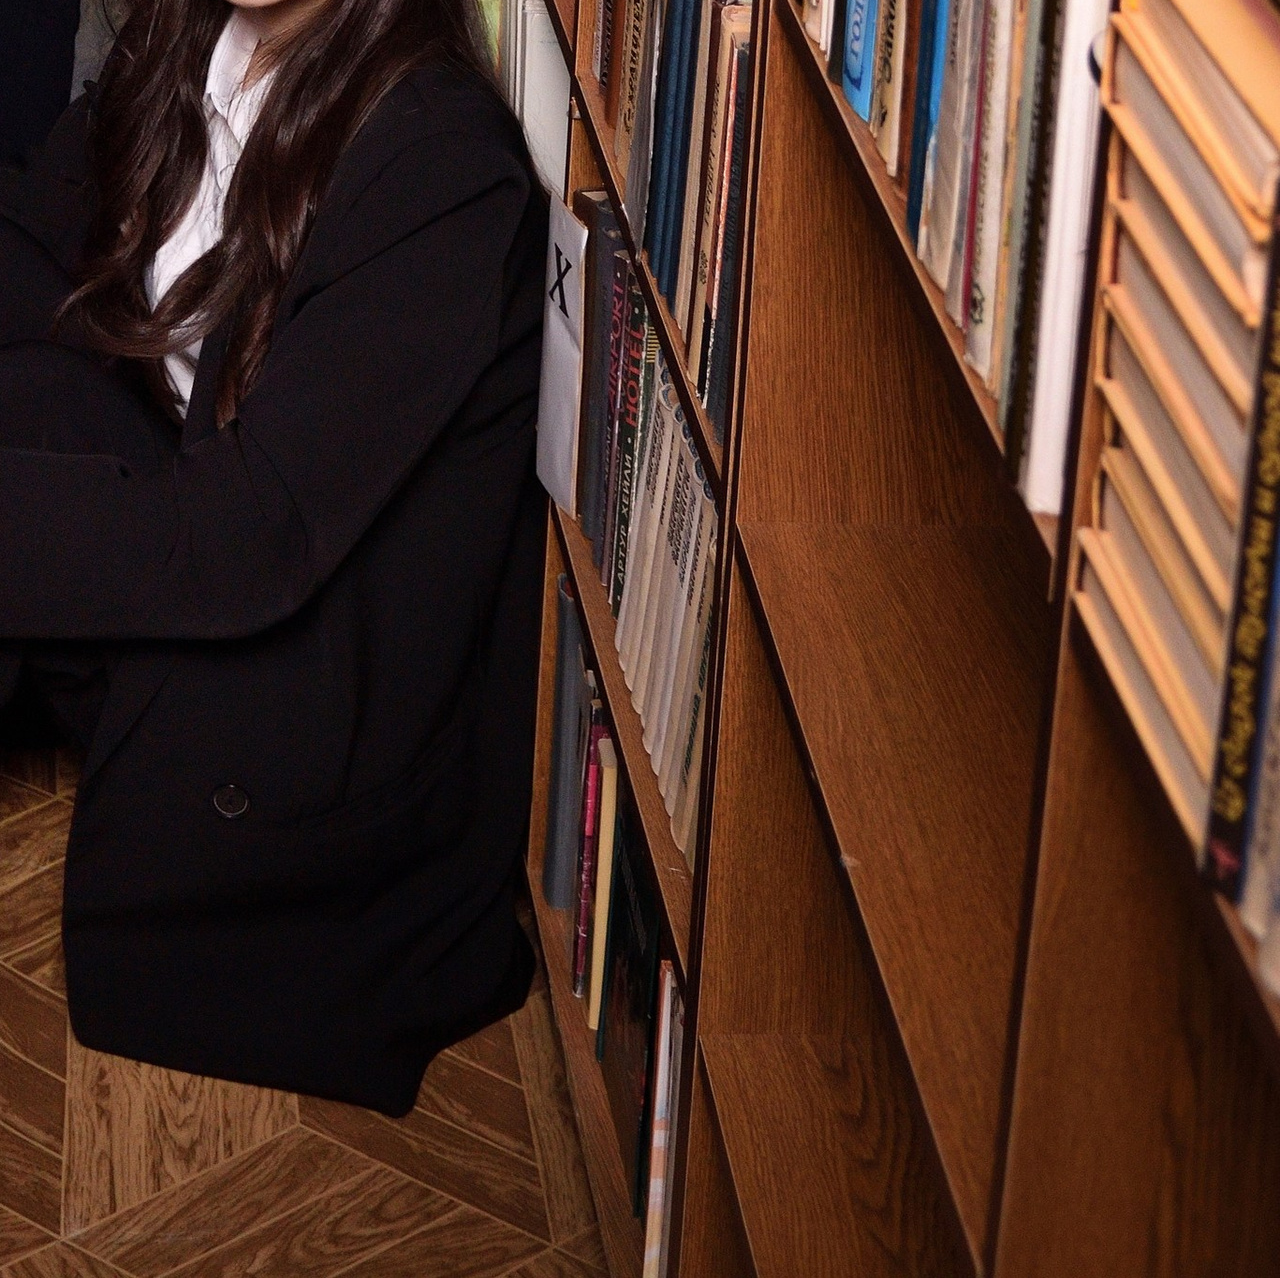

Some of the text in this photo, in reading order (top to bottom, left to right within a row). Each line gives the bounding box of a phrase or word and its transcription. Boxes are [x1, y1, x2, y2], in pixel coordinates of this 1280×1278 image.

[607, 282, 623, 411] AIRPORT
[626, 326, 643, 426] HOTEL
[617, 454, 631, 583] АРТУР ХЕЙЛИ
